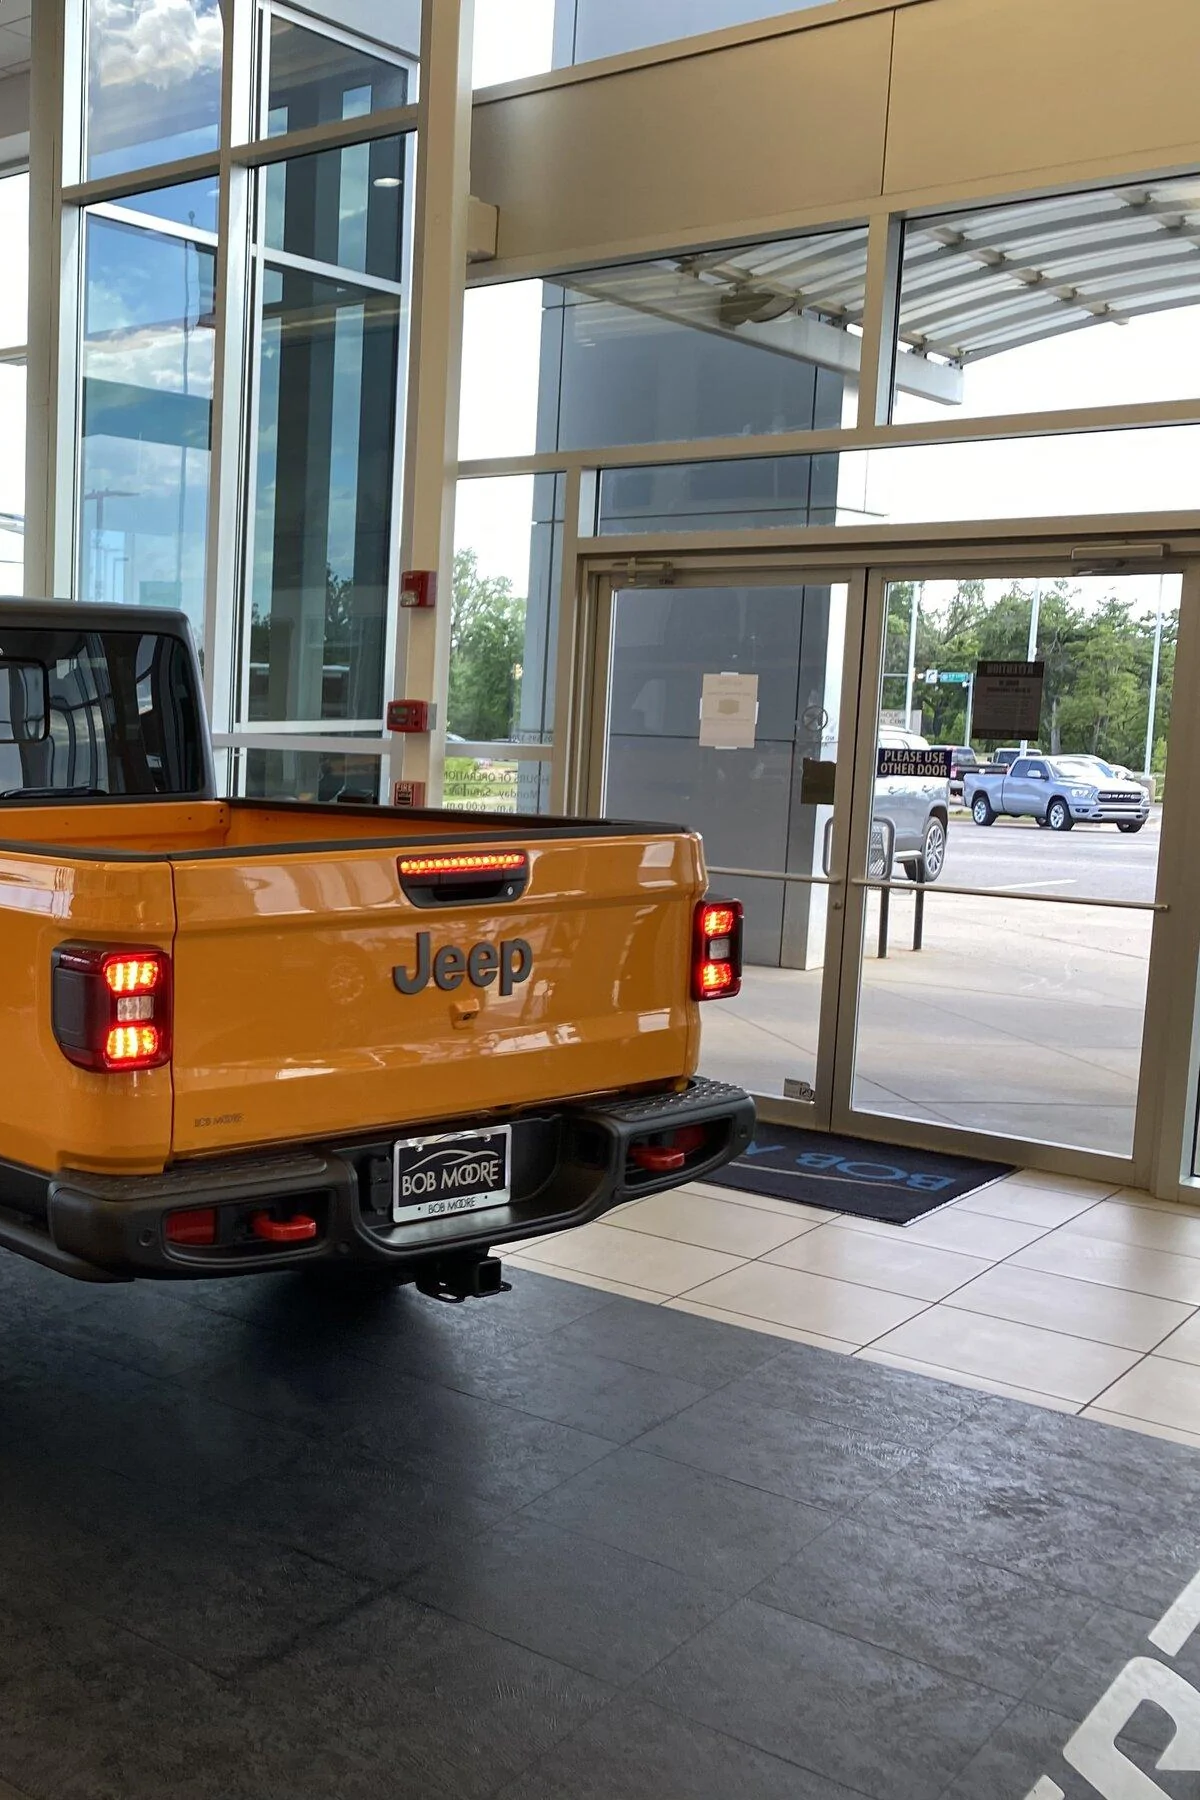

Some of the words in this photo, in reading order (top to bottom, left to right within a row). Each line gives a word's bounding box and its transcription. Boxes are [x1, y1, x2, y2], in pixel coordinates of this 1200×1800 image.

[884, 750, 922, 762] PLEASE
[924, 751, 945, 764] USE
[880, 762, 915, 775] OTHER
[917, 763, 947, 776] DOOR
[397, 783, 412, 791] FIRE
[392, 931, 534, 996] Jeep
[402, 1171, 437, 1196] BOB
[440, 1160, 499, 1190] MOORE
[795, 1151, 957, 1192] BOB
[428, 1201, 446, 1214] BOB
[446, 1197, 476, 1211] MOORE
